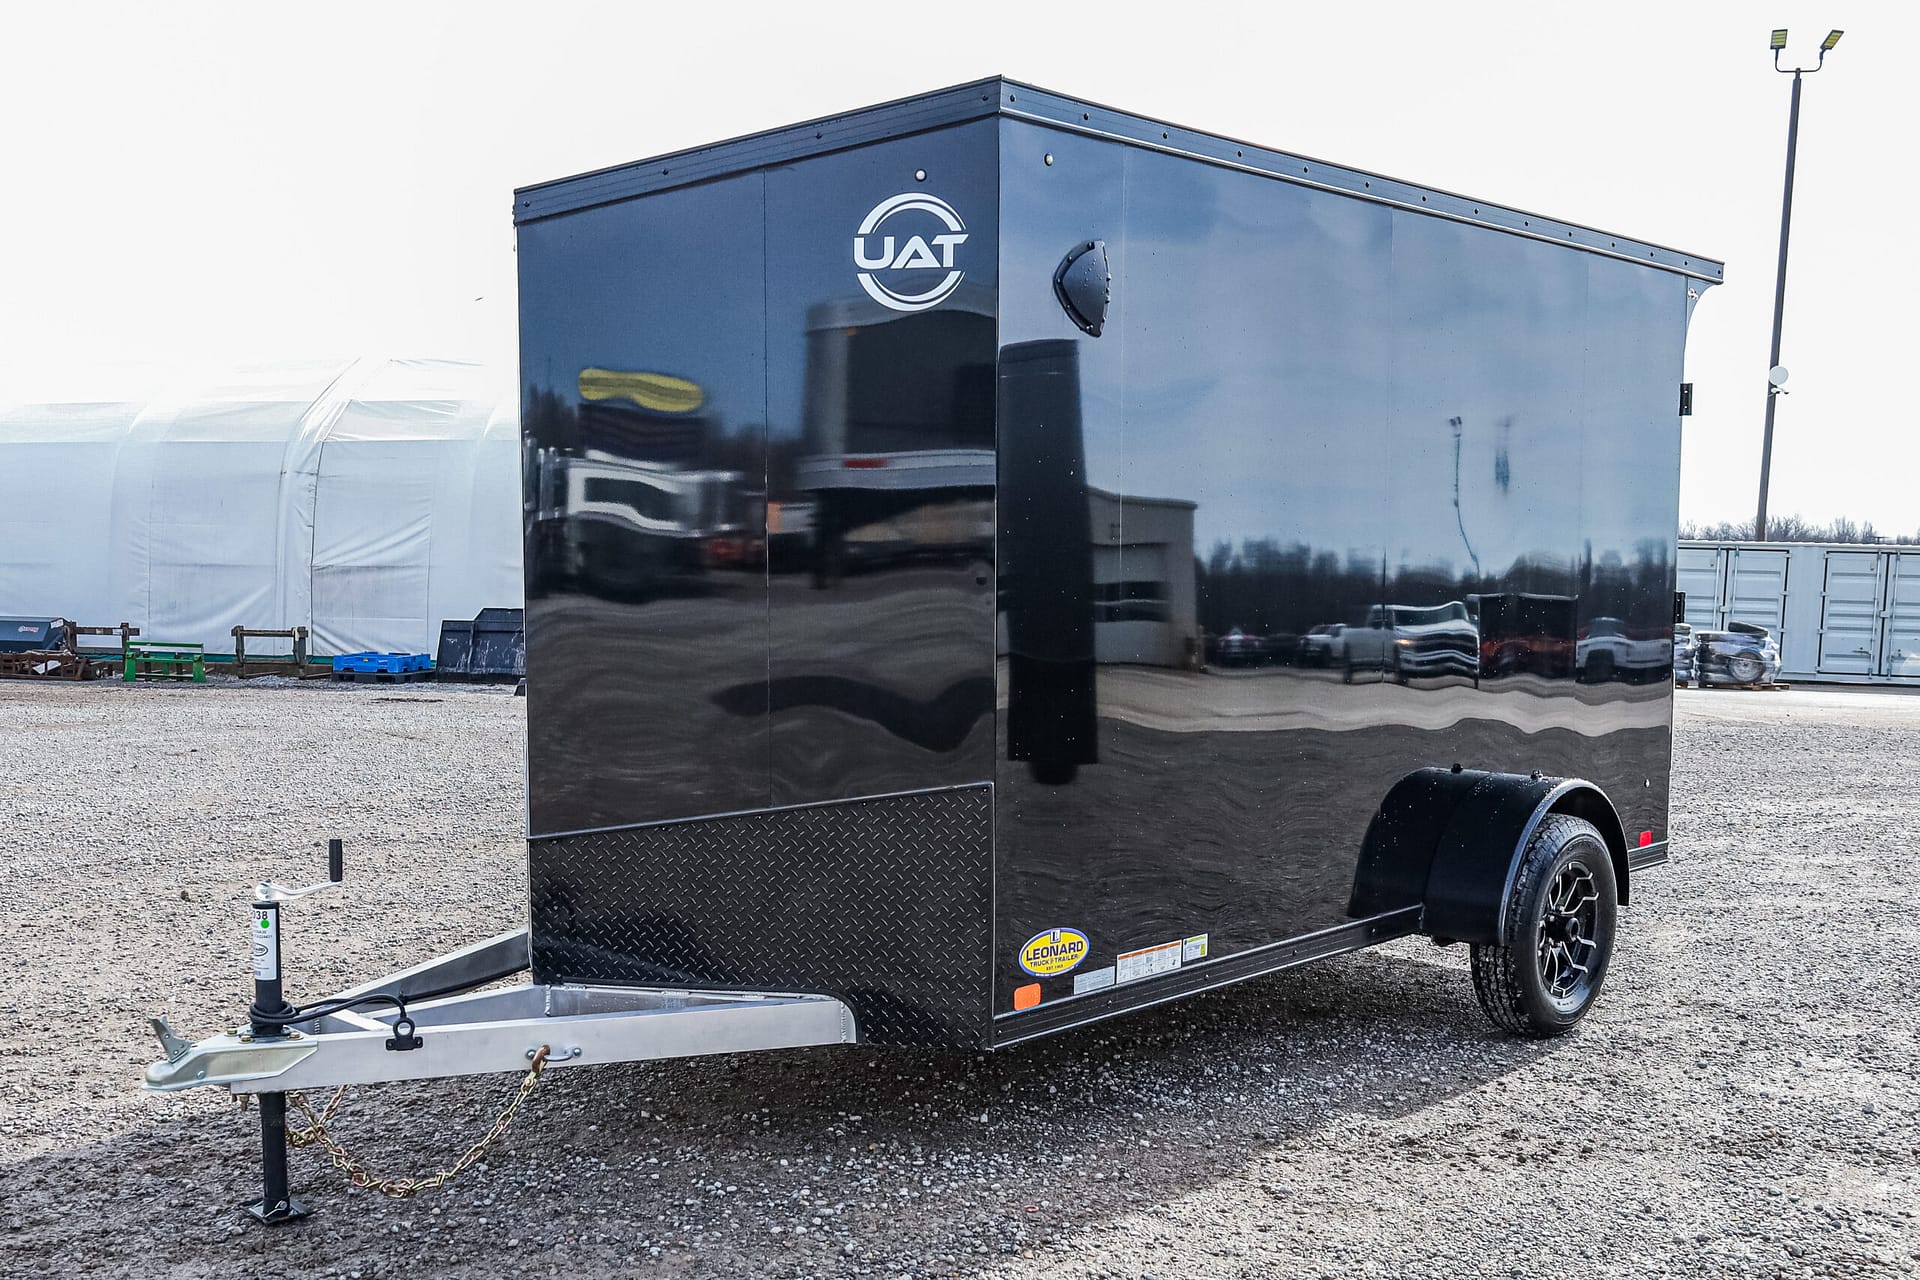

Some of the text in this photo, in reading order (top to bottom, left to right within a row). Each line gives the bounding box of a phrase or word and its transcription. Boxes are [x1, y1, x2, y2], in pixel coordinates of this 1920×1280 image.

[854, 233, 969, 270] UAT
[1026, 940, 1084, 962] LEONARD
[1030, 958, 1050, 968] TRUCK
[1054, 953, 1079, 964] TRAILER
